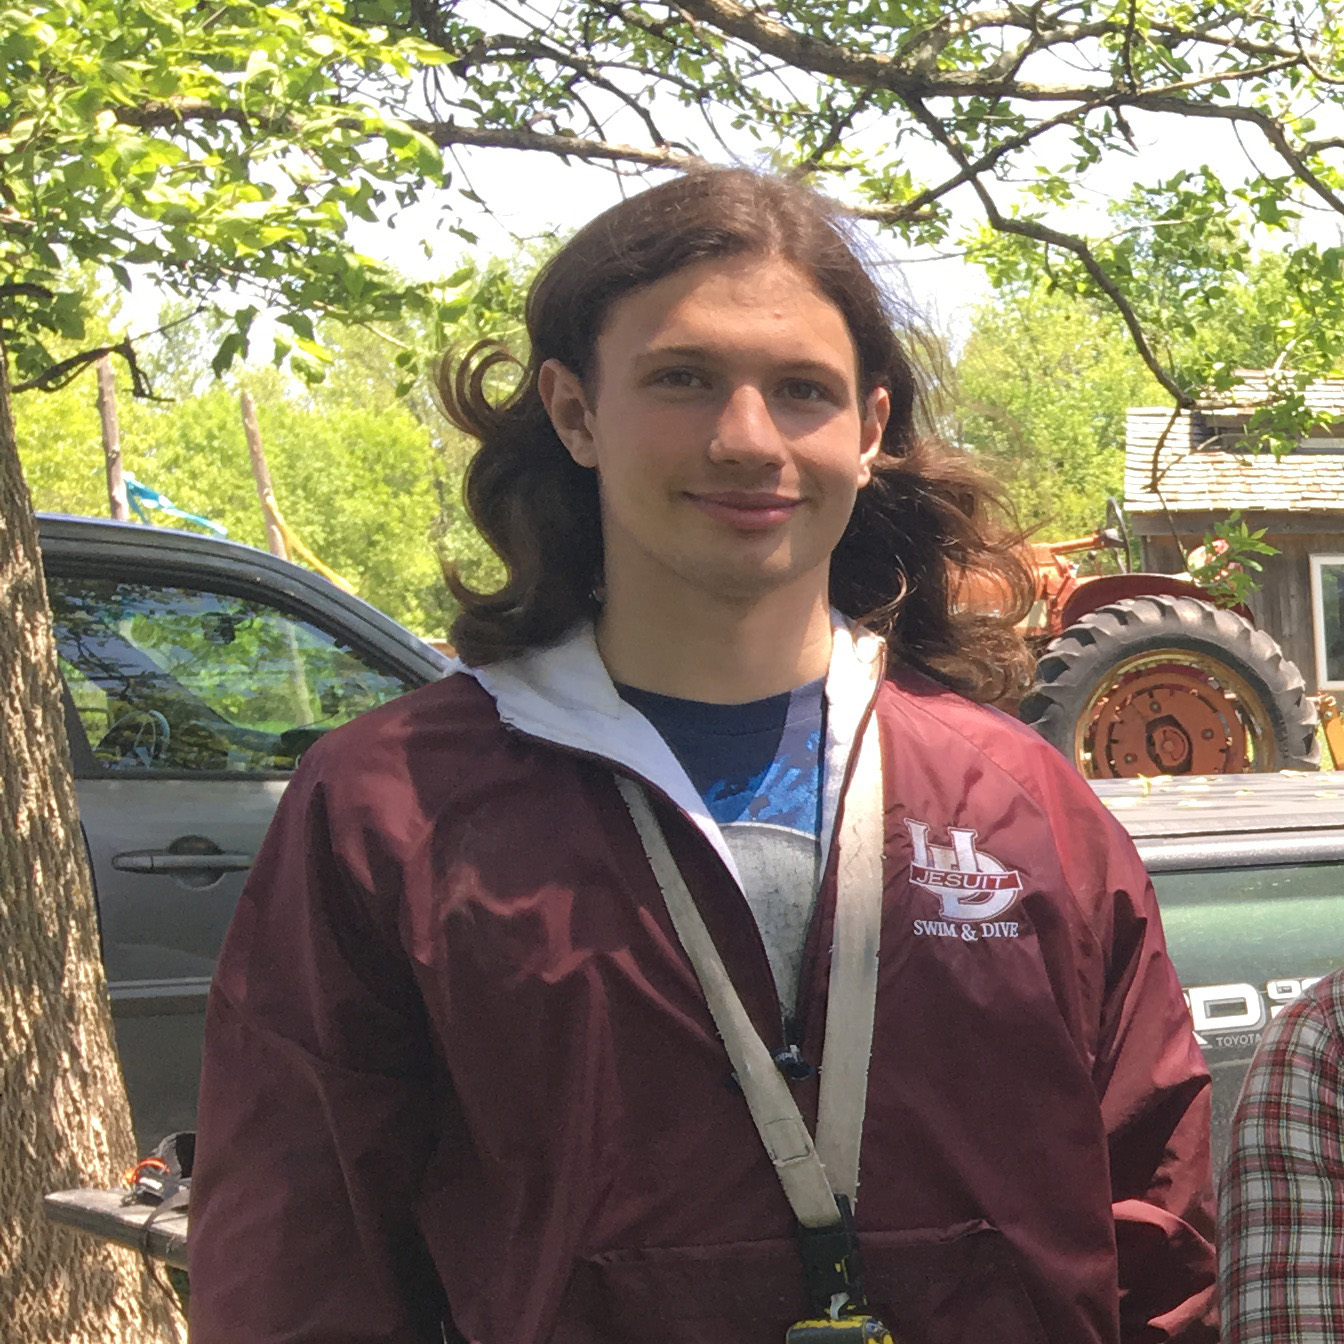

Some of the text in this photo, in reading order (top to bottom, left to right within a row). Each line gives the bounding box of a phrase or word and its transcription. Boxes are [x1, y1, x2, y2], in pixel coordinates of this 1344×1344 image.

[915, 869, 1009, 890] JESUIT
[913, 919, 1019, 942] SWIM & DIVE
